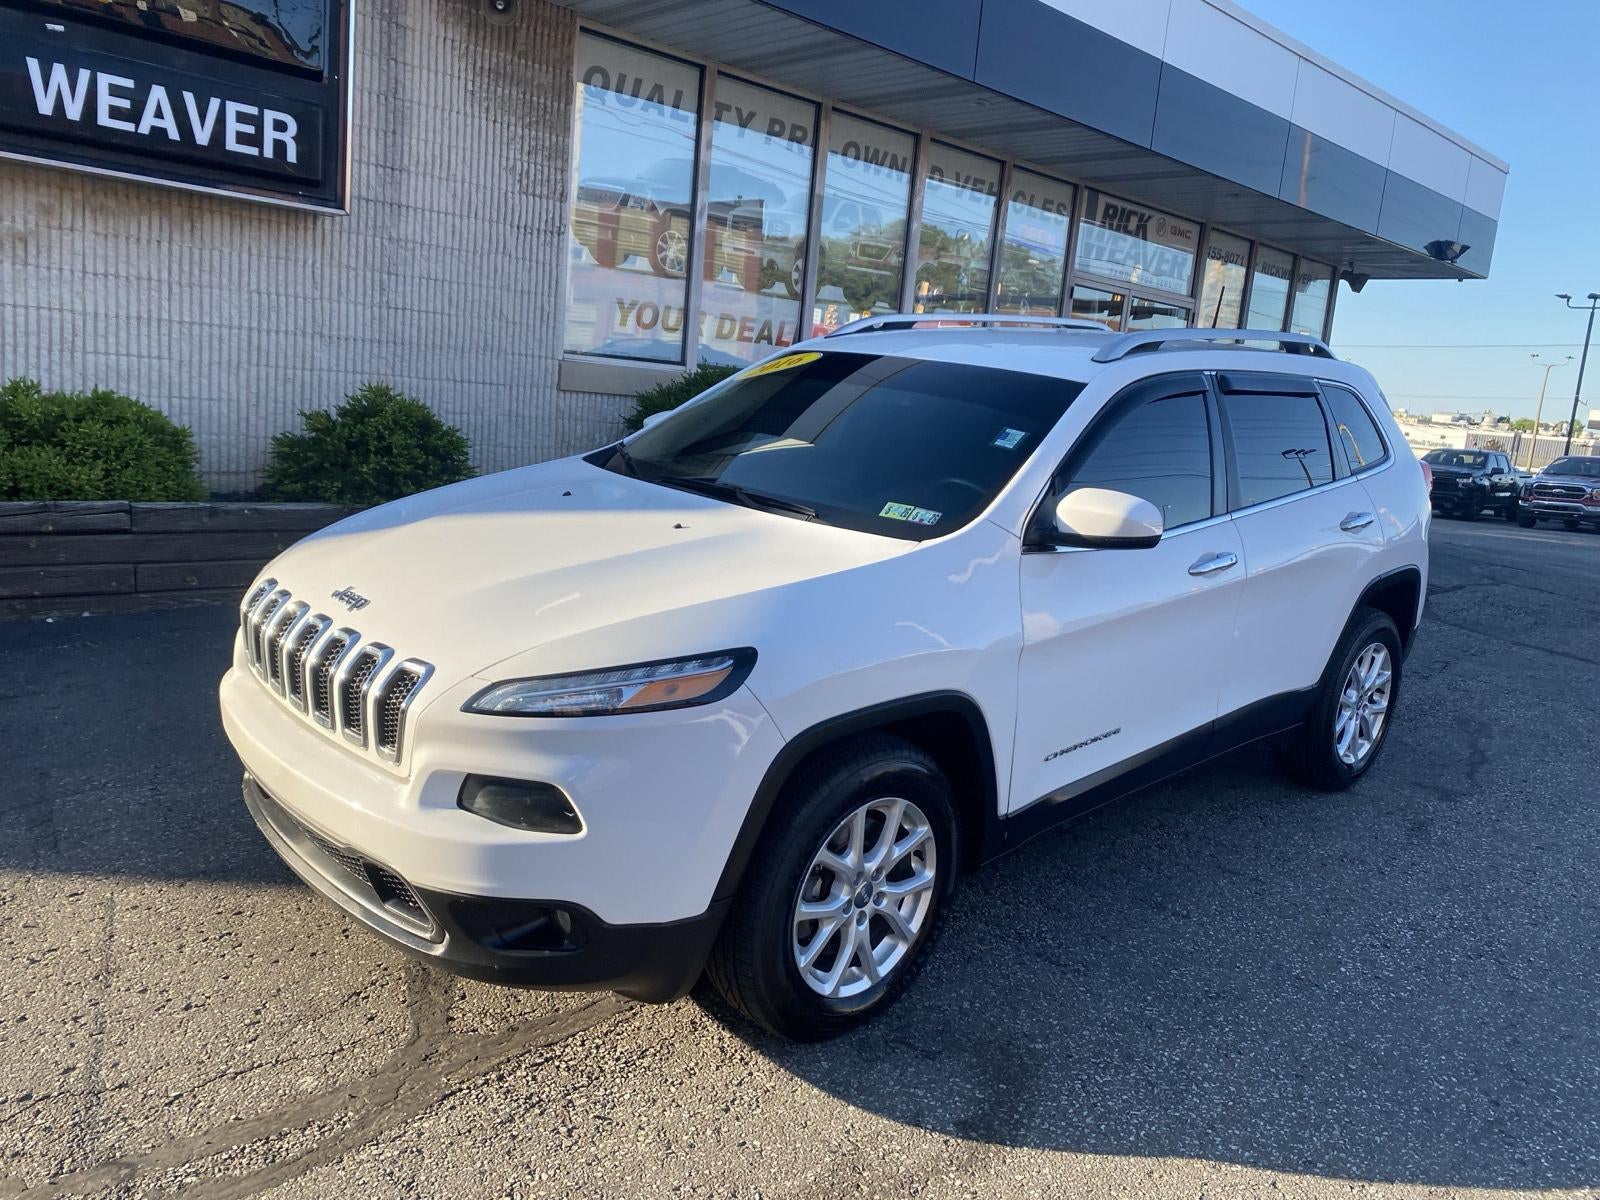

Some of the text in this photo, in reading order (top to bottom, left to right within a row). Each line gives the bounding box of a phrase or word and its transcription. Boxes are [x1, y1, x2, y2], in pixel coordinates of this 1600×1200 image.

[25, 56, 298, 164] WEAVER
[581, 65, 1070, 226] QUALTY PR-OWND VEHCLES
[1102, 202, 1154, 241] RICK
[1170, 225, 1192, 240] GMC
[1081, 226, 1188, 280] WEAVER
[331, 586, 371, 612] Jeep
[1044, 727, 1122, 761] CHEROKEE
